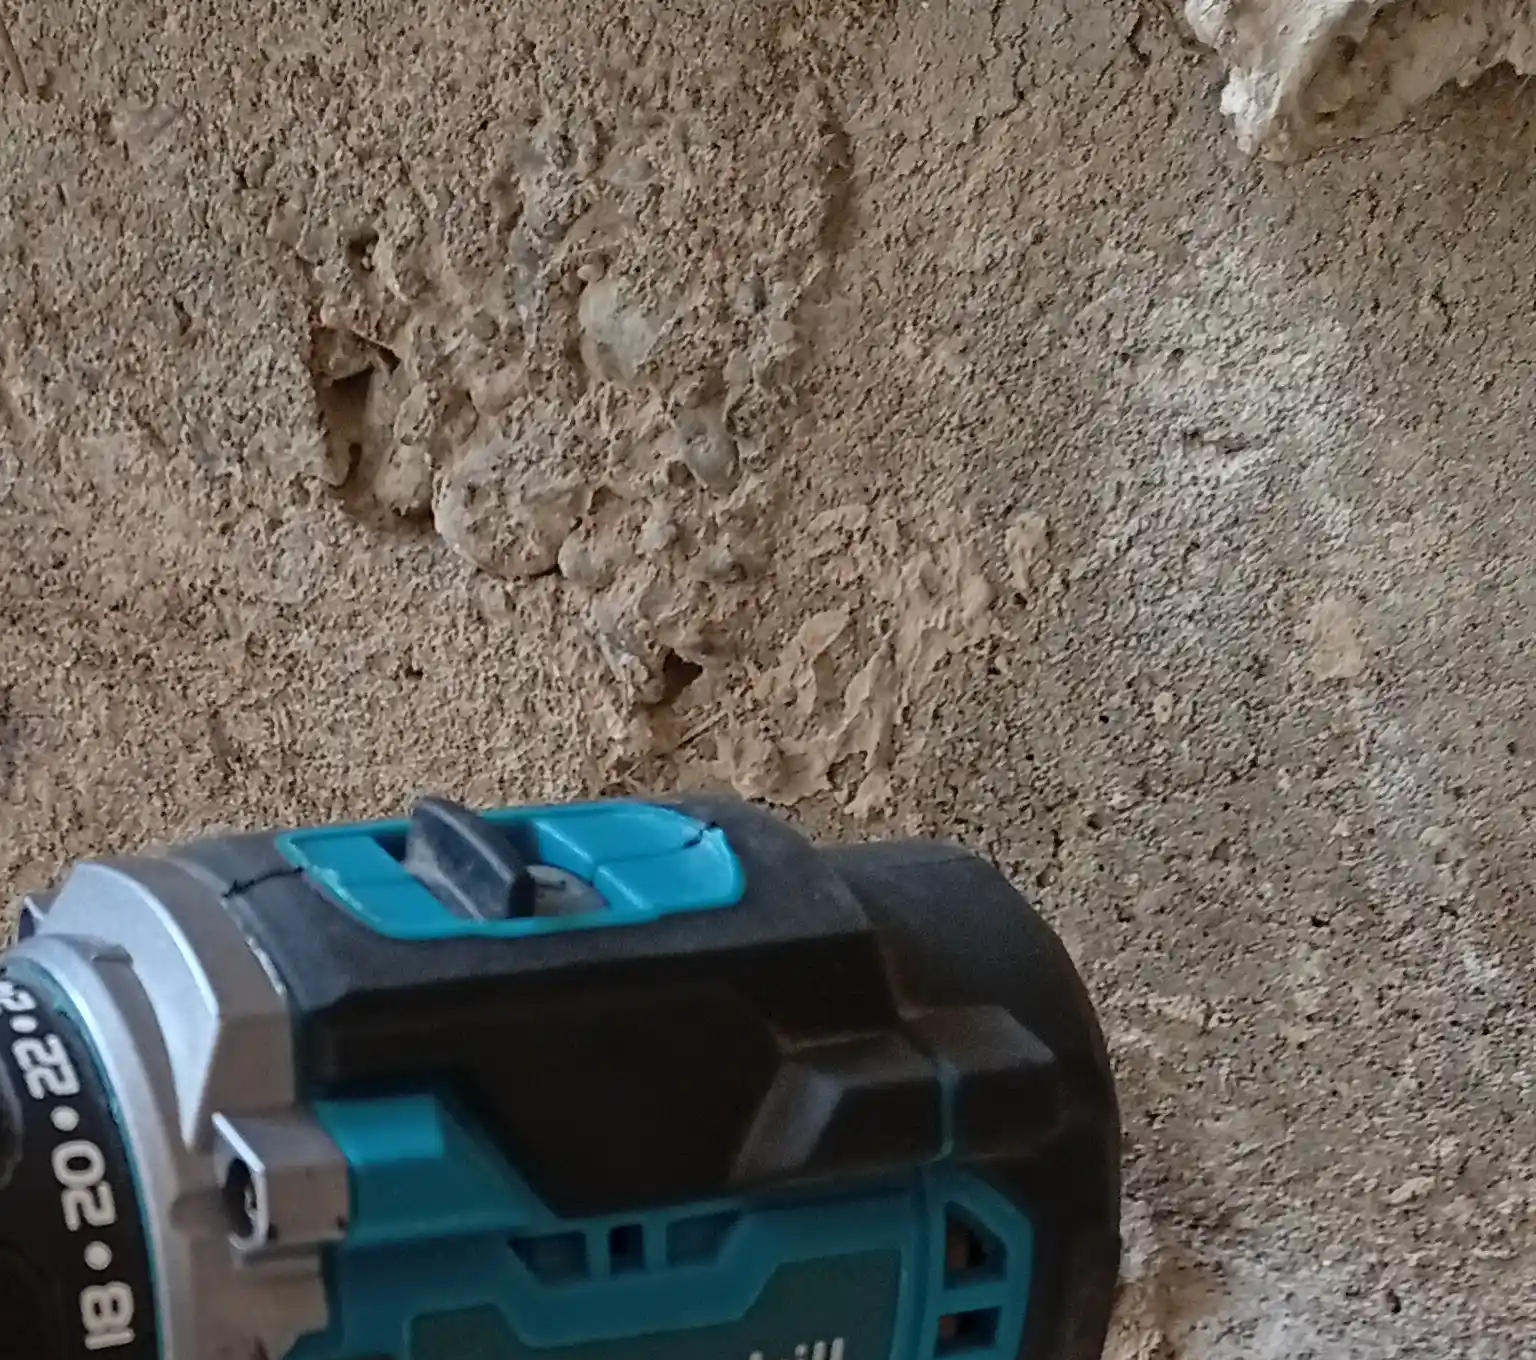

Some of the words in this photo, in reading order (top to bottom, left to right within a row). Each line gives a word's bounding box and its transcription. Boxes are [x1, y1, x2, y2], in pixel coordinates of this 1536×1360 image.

[11, 1033, 81, 1100] 22
[51, 1139, 117, 1232] 20
[79, 1281, 135, 1351] 18
